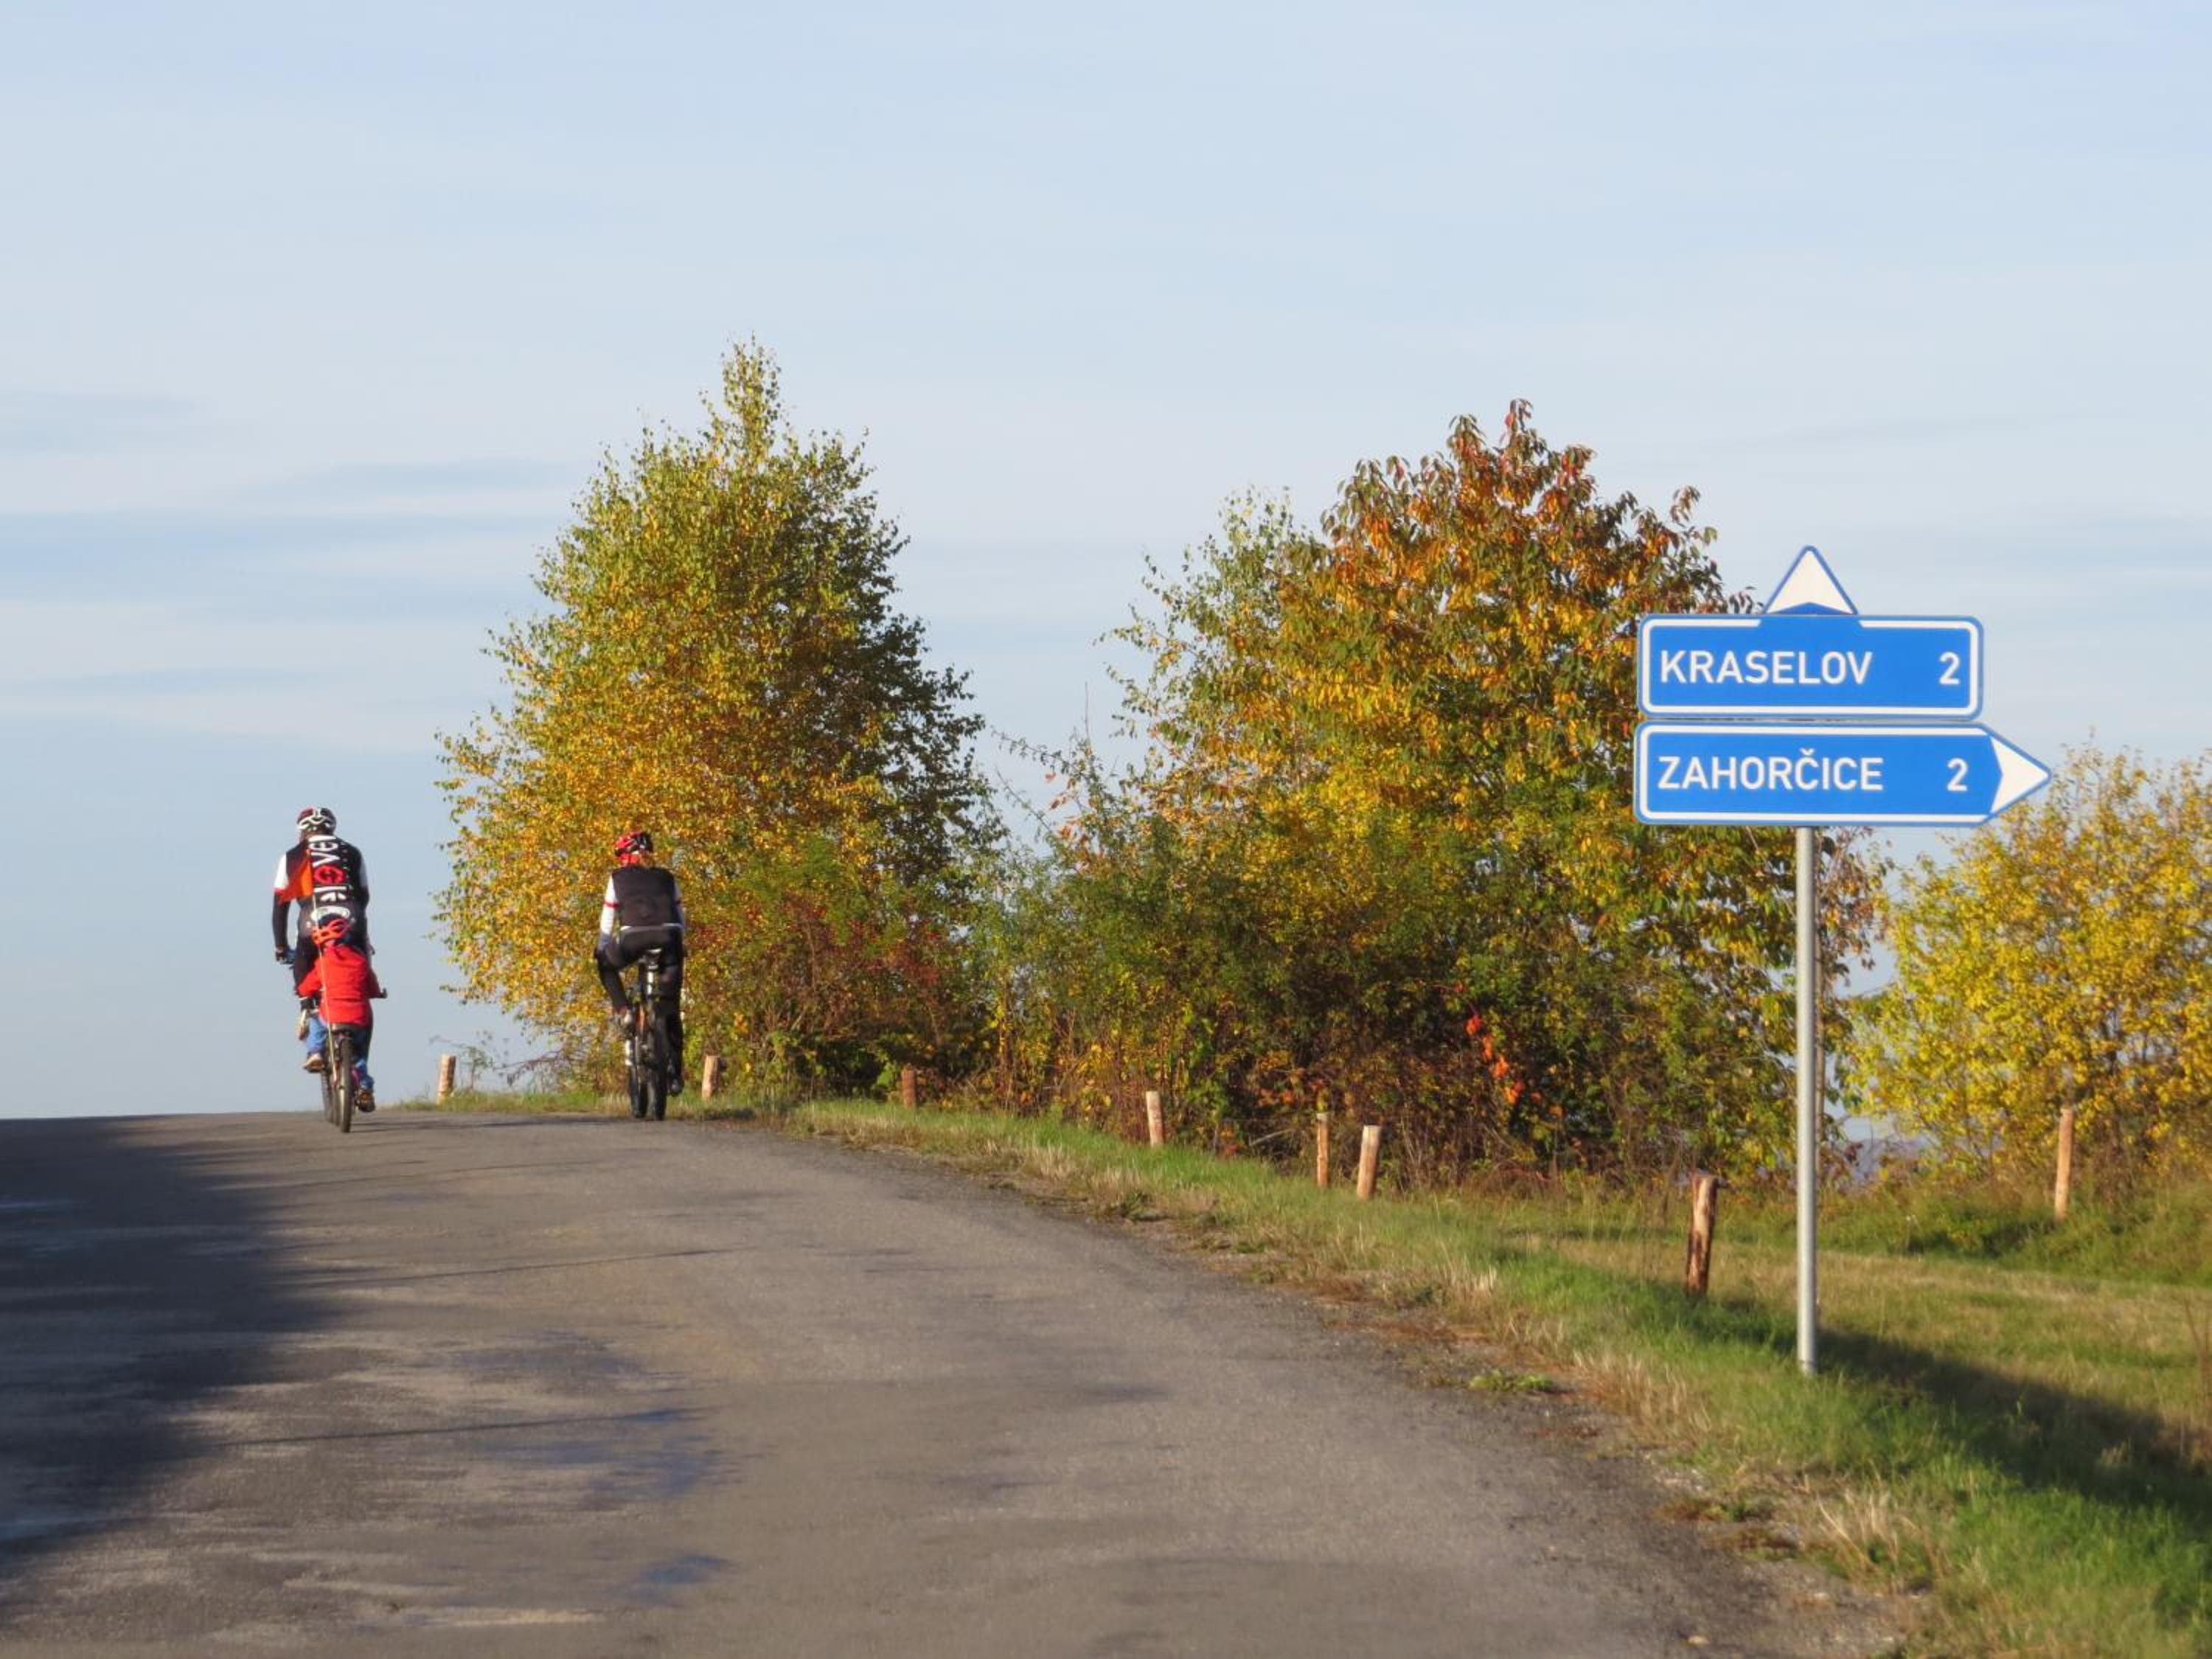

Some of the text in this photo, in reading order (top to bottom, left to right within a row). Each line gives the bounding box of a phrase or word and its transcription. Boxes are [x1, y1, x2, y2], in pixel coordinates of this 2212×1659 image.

[1660, 650, 1961, 685] KRASELOV 2
[1658, 748, 1969, 792] ZAHORČICE 2
